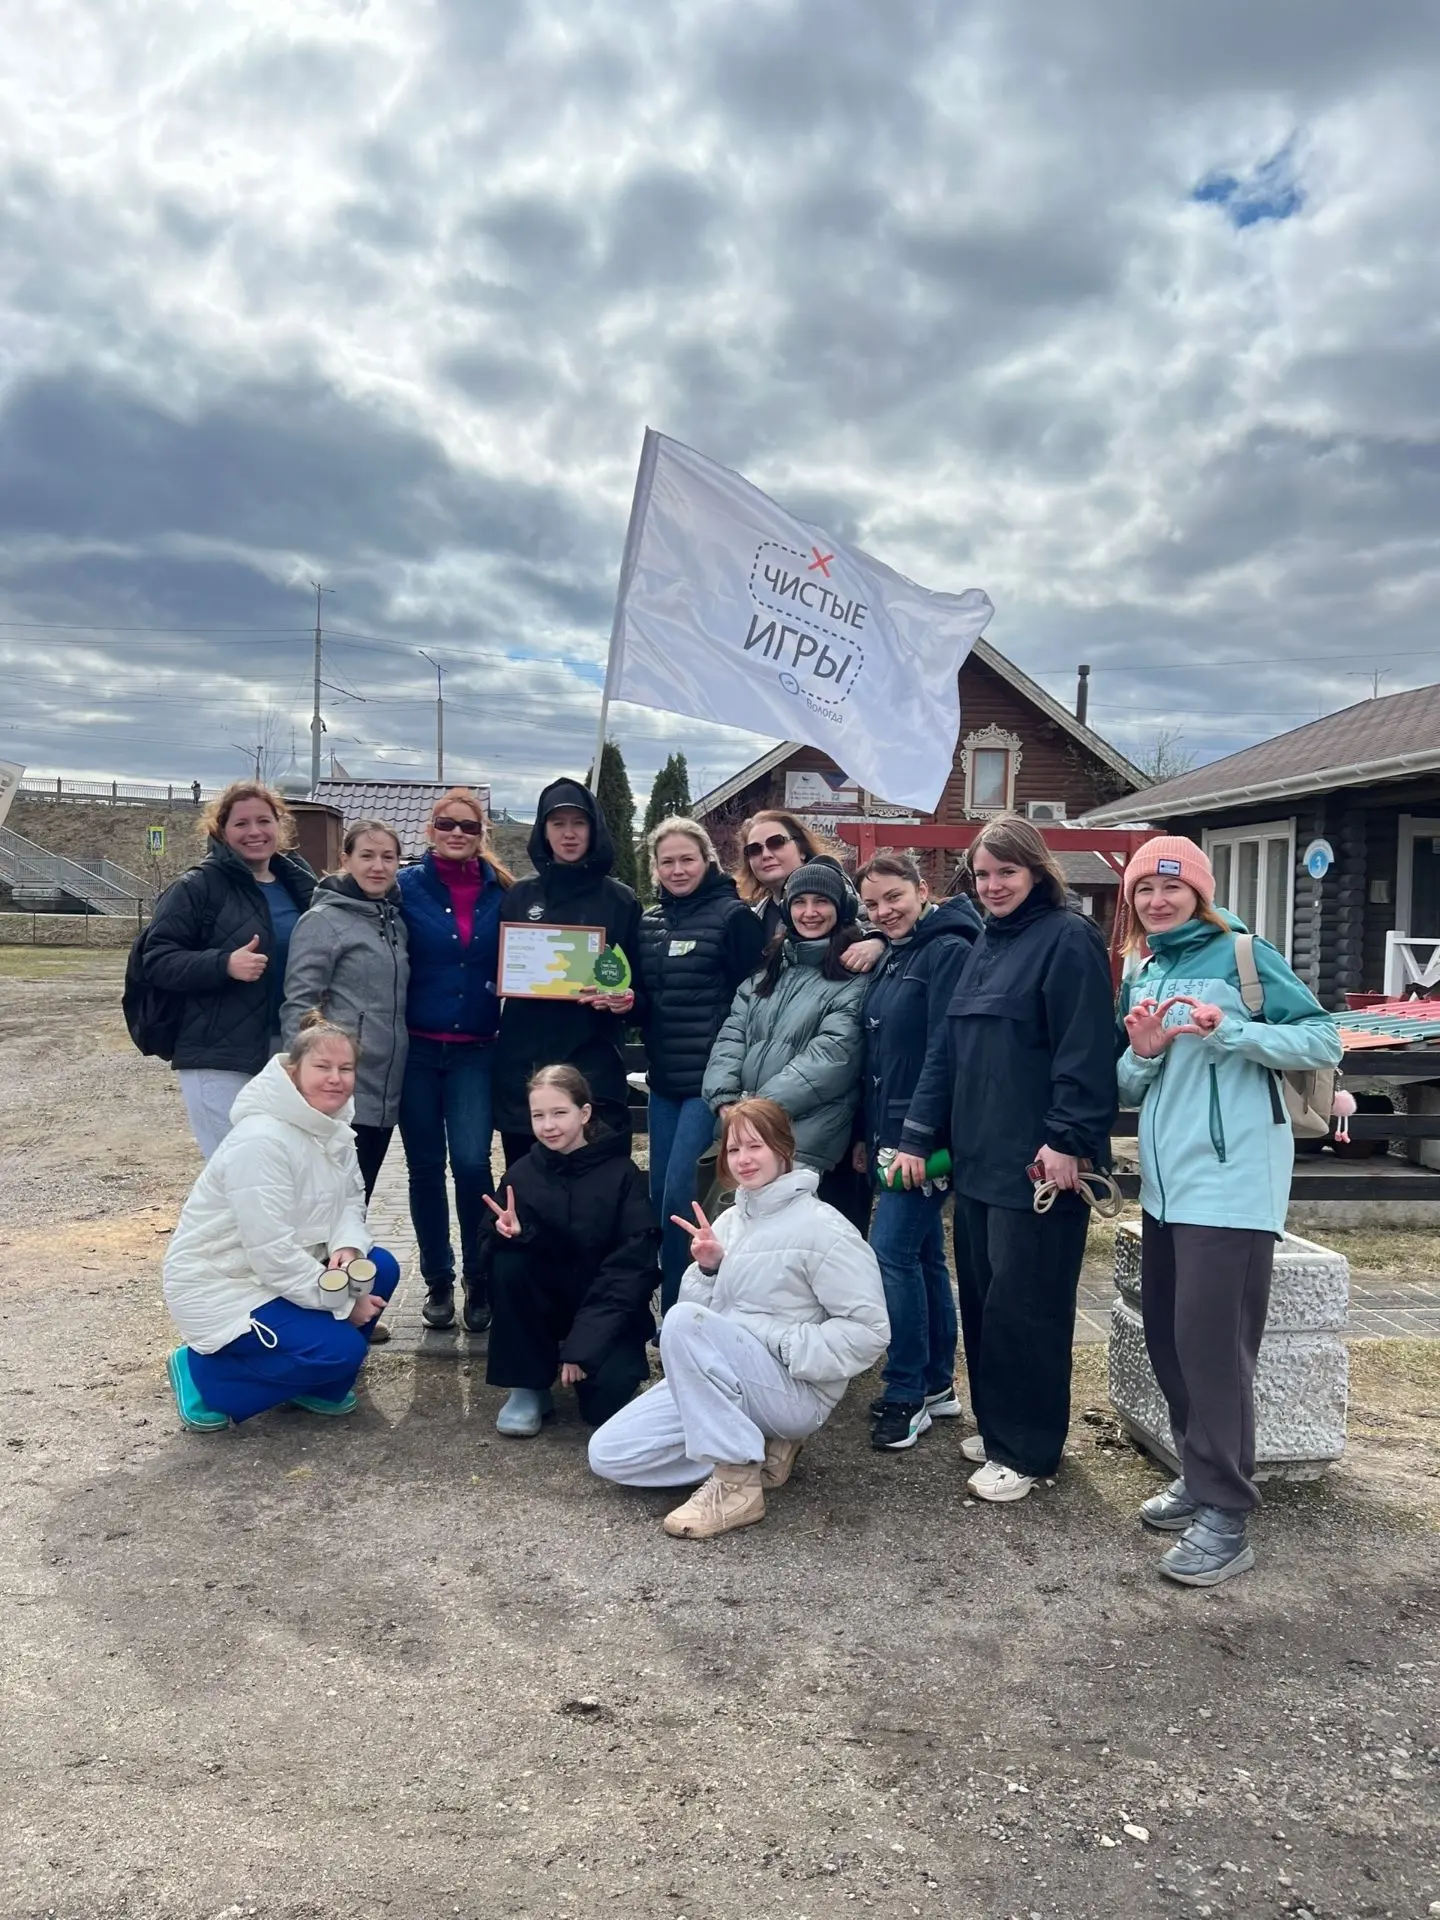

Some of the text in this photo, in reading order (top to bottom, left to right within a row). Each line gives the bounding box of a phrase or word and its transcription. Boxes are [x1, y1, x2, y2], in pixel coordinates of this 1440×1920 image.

[763, 565, 868, 630] ЧИСТЫЕ
[743, 614, 852, 684] ИГРЫ
[806, 698, 843, 723] Вологда
